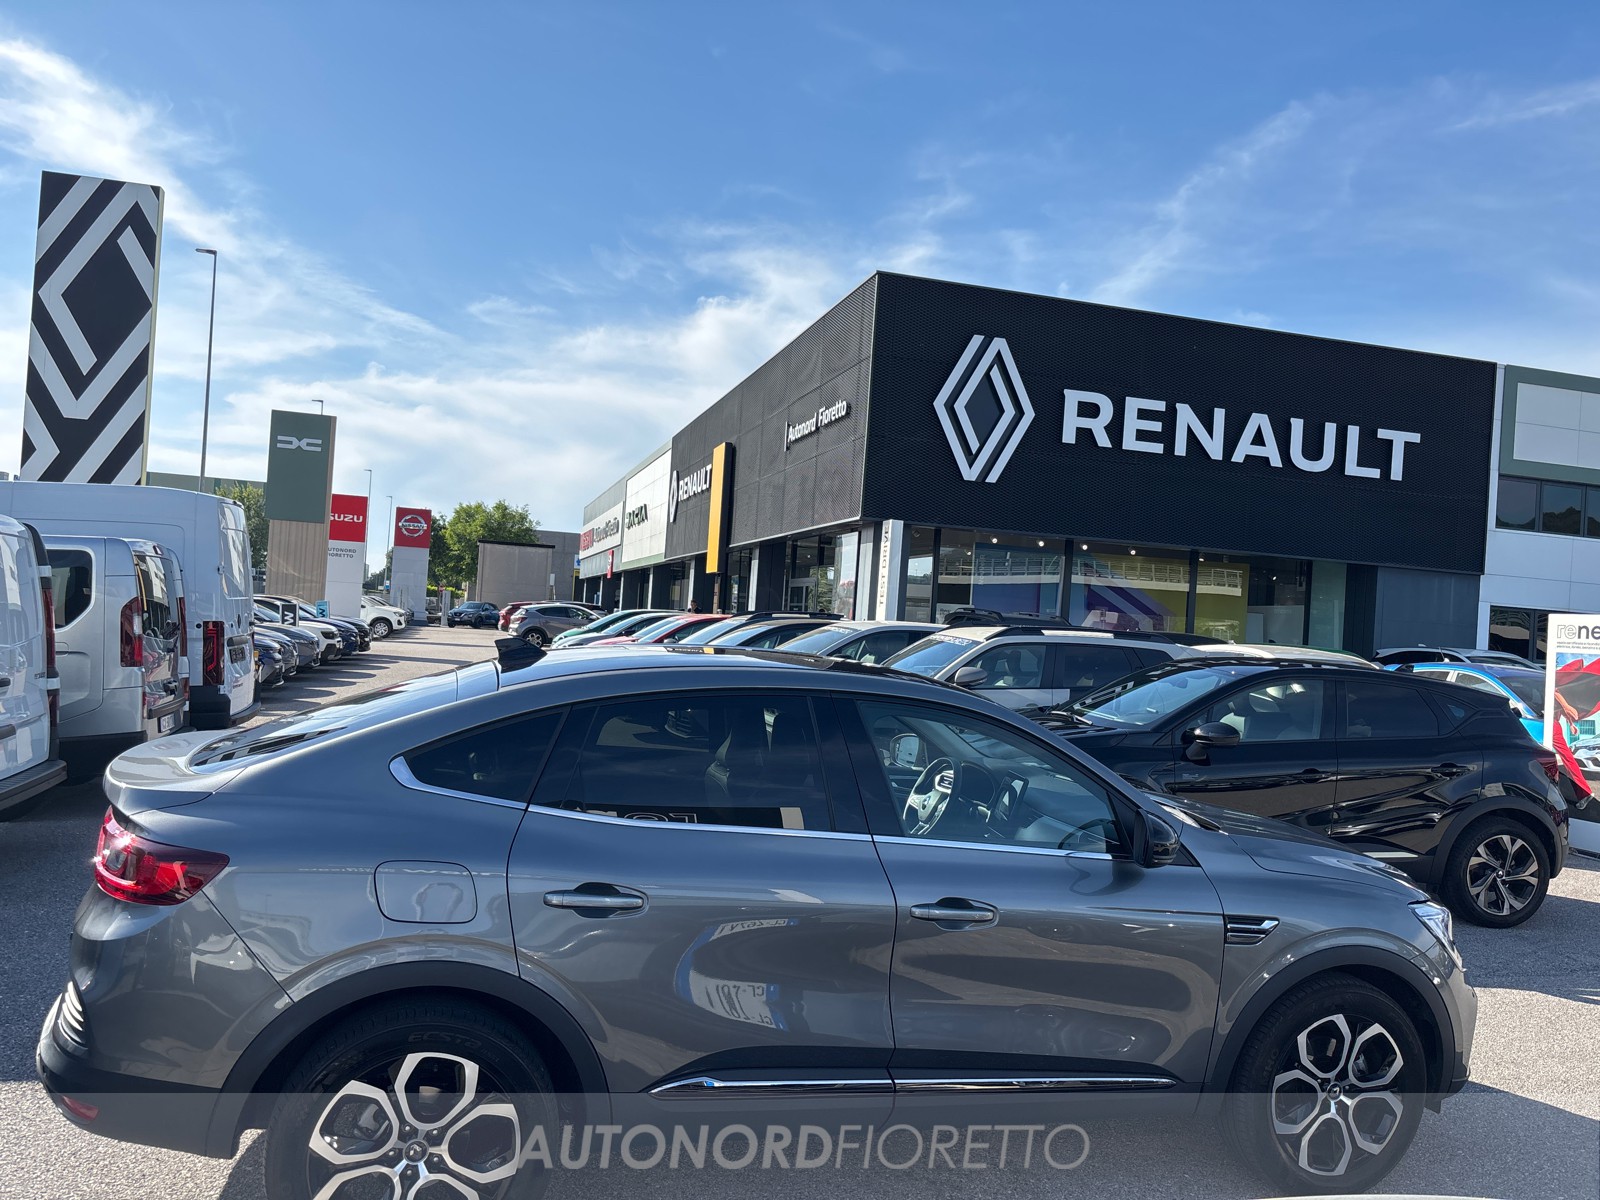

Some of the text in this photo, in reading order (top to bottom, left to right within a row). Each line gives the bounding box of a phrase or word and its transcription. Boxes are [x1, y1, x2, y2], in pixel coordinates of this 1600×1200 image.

[787, 399, 847, 443] Autonord Fioretto
[1062, 389, 1421, 481] RENAULT
[679, 463, 713, 502] RENAULT
[329, 513, 363, 523] SUZU
[879, 526, 890, 606] TEST DRIVE
